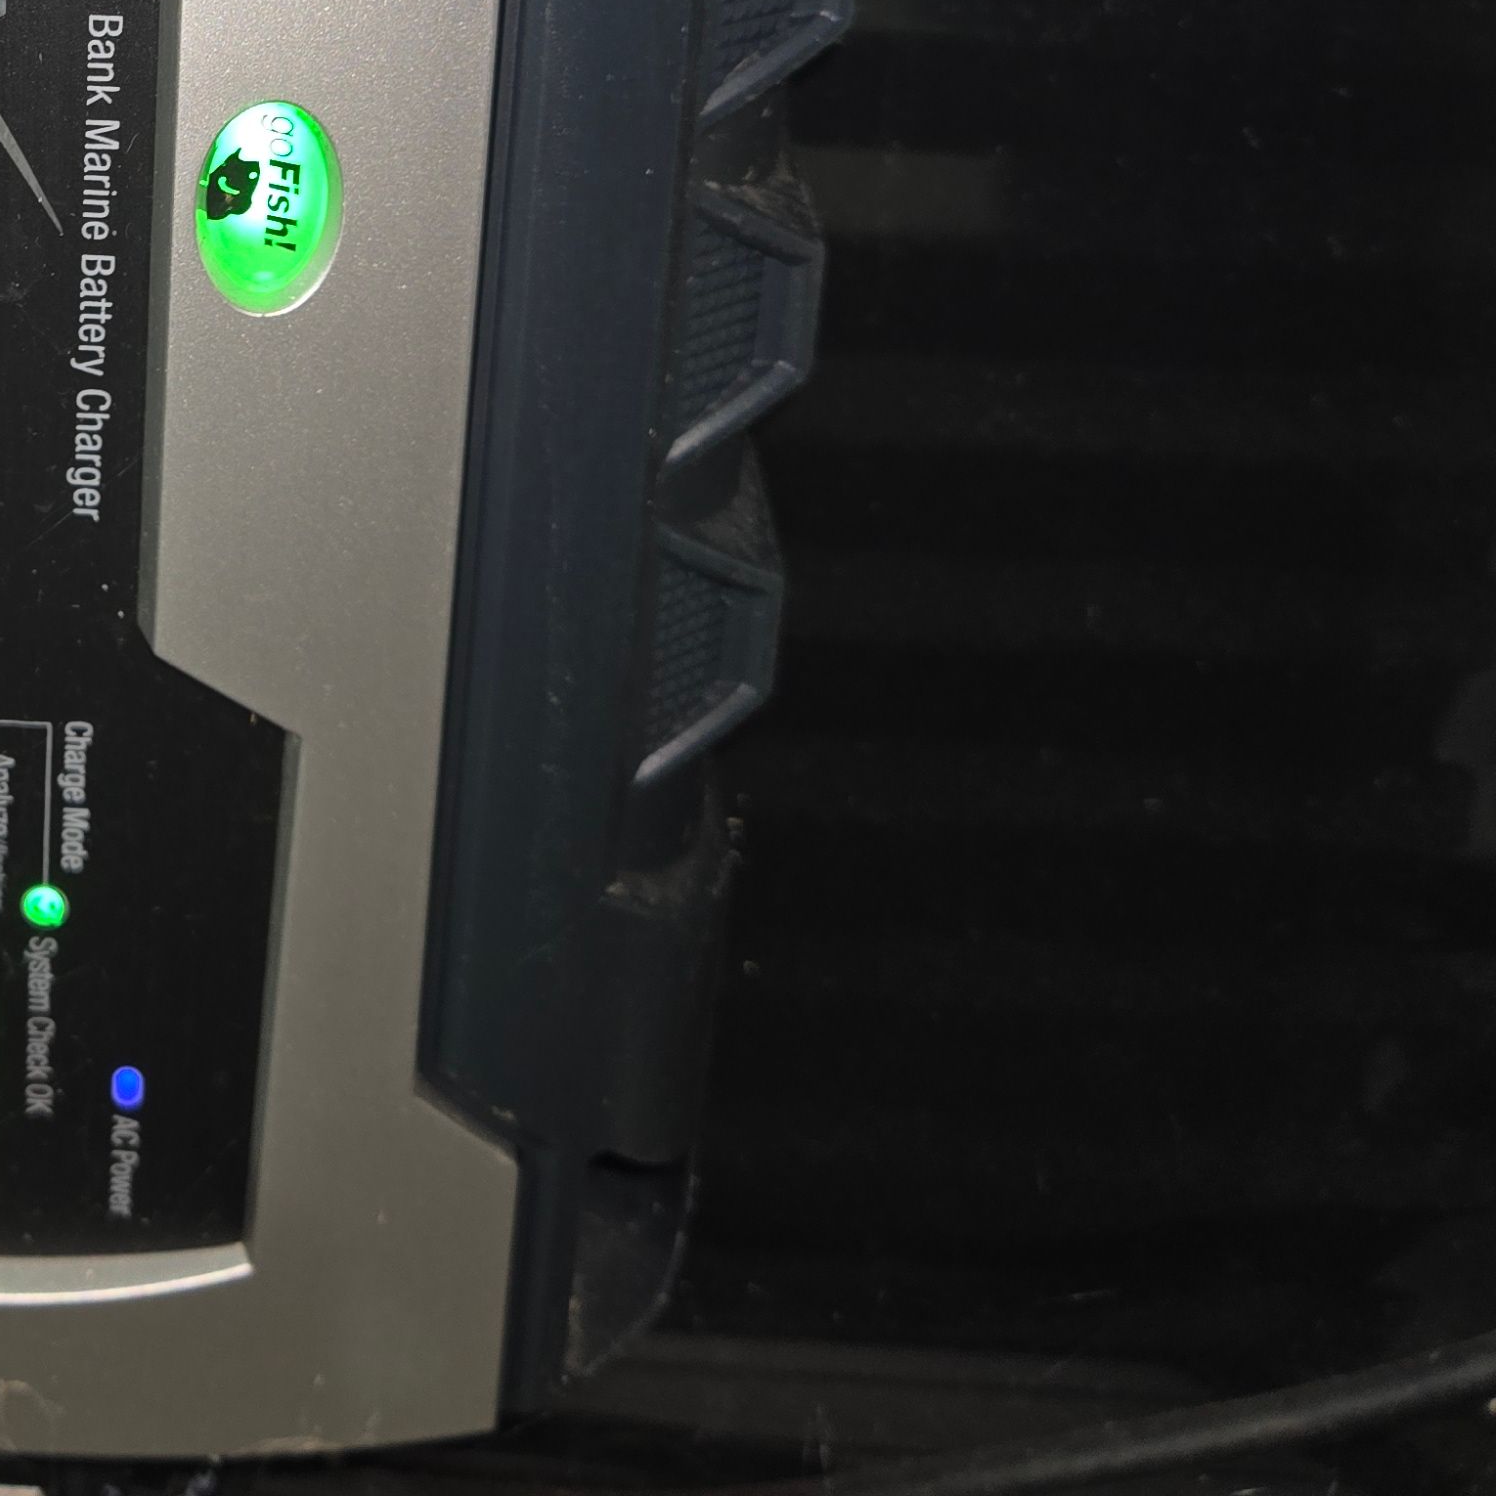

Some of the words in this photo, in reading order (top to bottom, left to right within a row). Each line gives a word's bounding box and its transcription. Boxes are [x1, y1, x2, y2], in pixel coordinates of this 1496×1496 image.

[85, 14, 124, 106] Bank
[80, 119, 120, 241] Marine
[69, 254, 116, 378] Battery
[65, 388, 111, 523] Charger
[57, 721, 93, 804] Charge
[59, 807, 91, 873] Mode
[23, 936, 58, 1012] System
[25, 1016, 56, 1080] Check
[25, 1083, 55, 1119] OK
[111, 1115, 140, 1147] AC
[109, 1149, 140, 1218] Power
